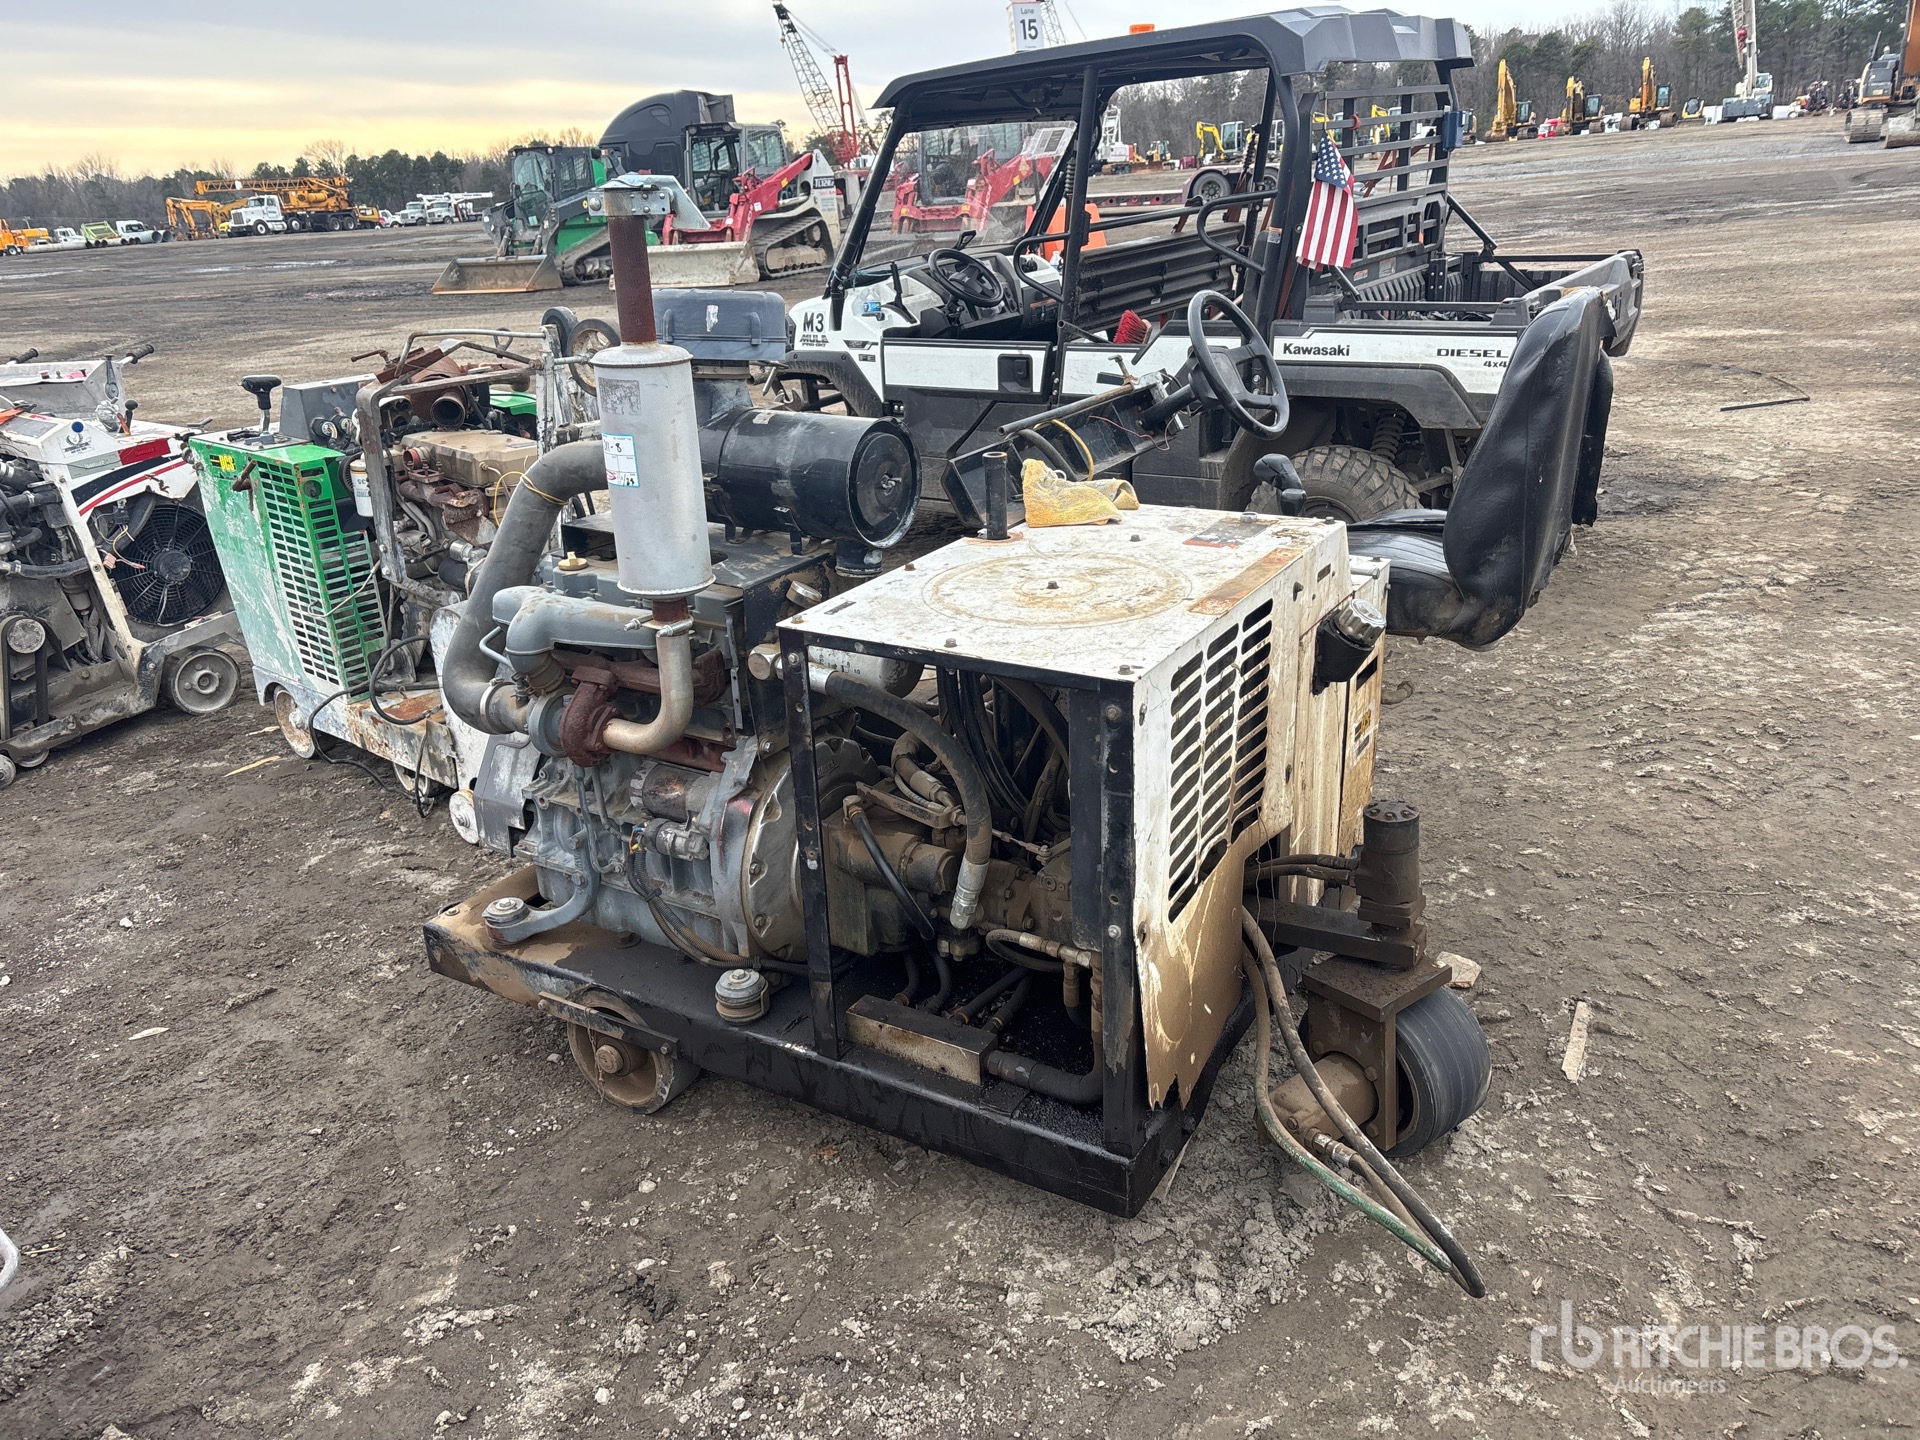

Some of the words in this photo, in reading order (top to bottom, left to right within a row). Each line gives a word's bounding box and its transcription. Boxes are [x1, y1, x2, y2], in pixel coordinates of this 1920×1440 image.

[1020, 7, 1035, 15] Lane
[1019, 18, 1039, 40] 15
[802, 311, 825, 333] M3
[1283, 342, 1351, 357] Kawasaki
[1436, 348, 1509, 359] DIESEL
[1483, 360, 1508, 368] 4x4
